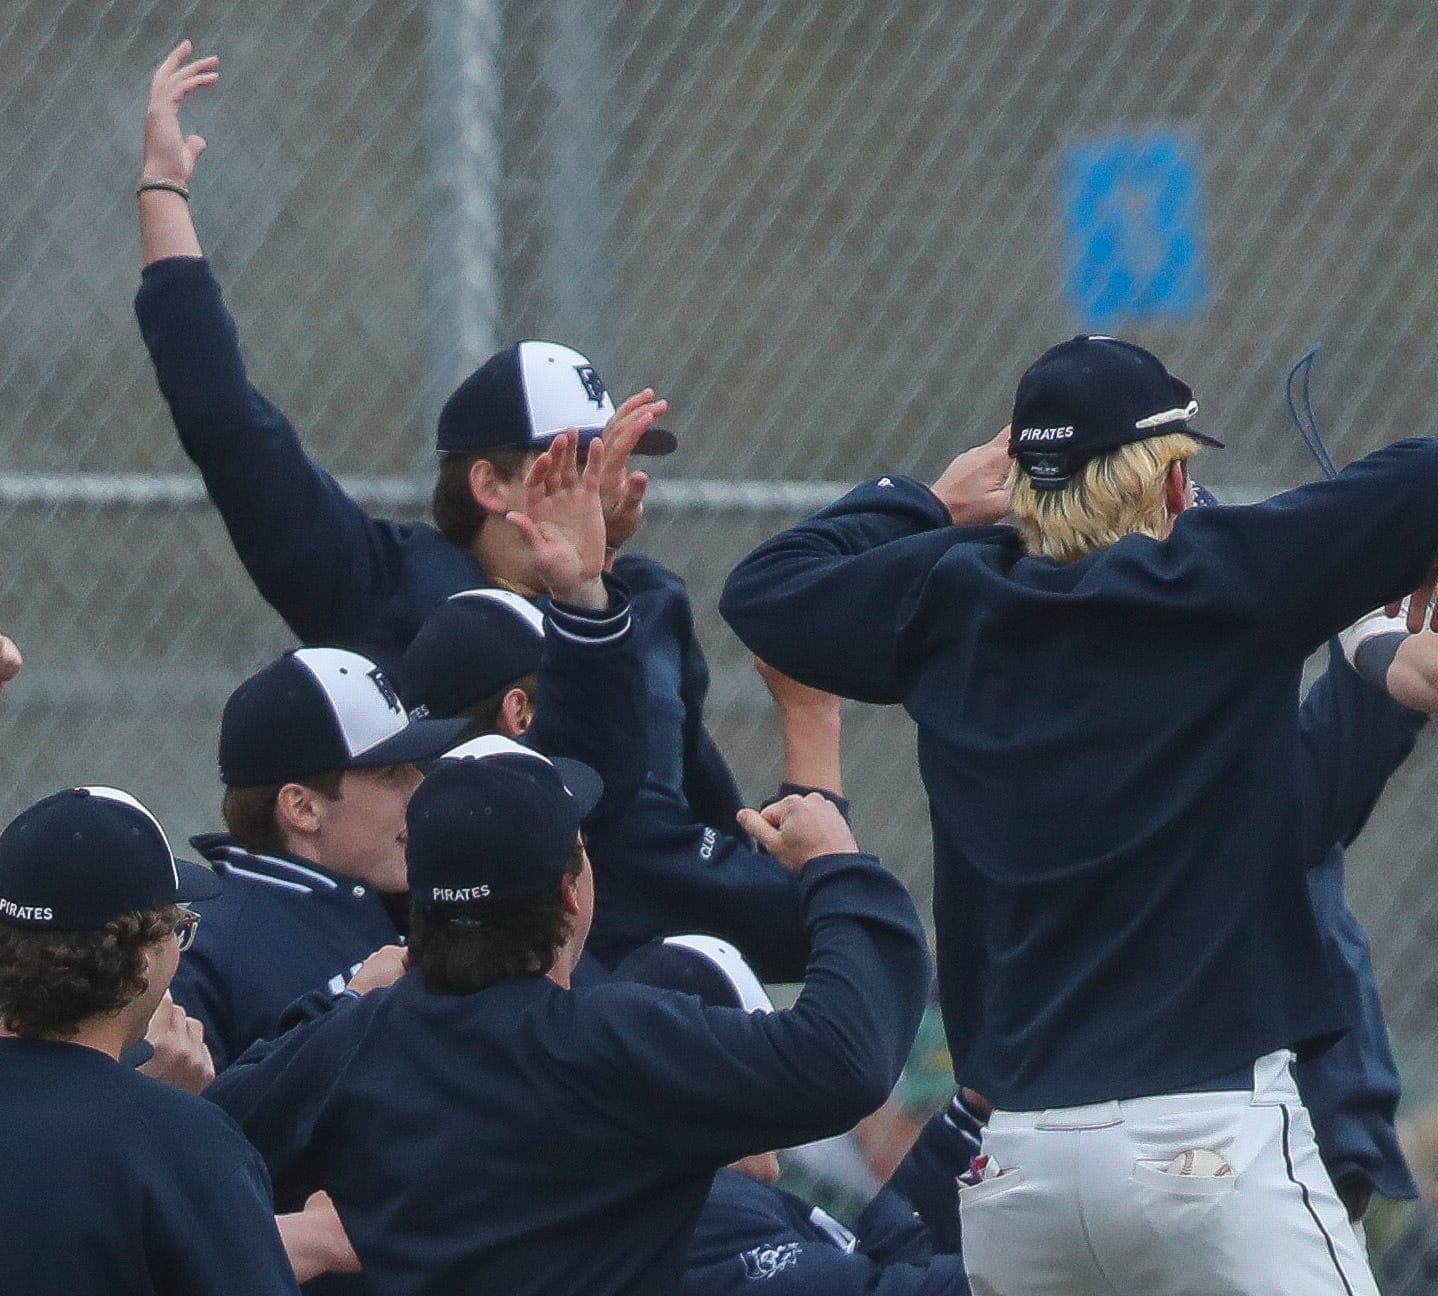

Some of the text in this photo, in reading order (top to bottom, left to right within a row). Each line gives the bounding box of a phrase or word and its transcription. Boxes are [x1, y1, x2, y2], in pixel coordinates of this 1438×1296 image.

[1020, 425, 1074, 441] PIRATES
[433, 884, 491, 901] PIRATES
[0, 898, 53, 920] PIRATES
